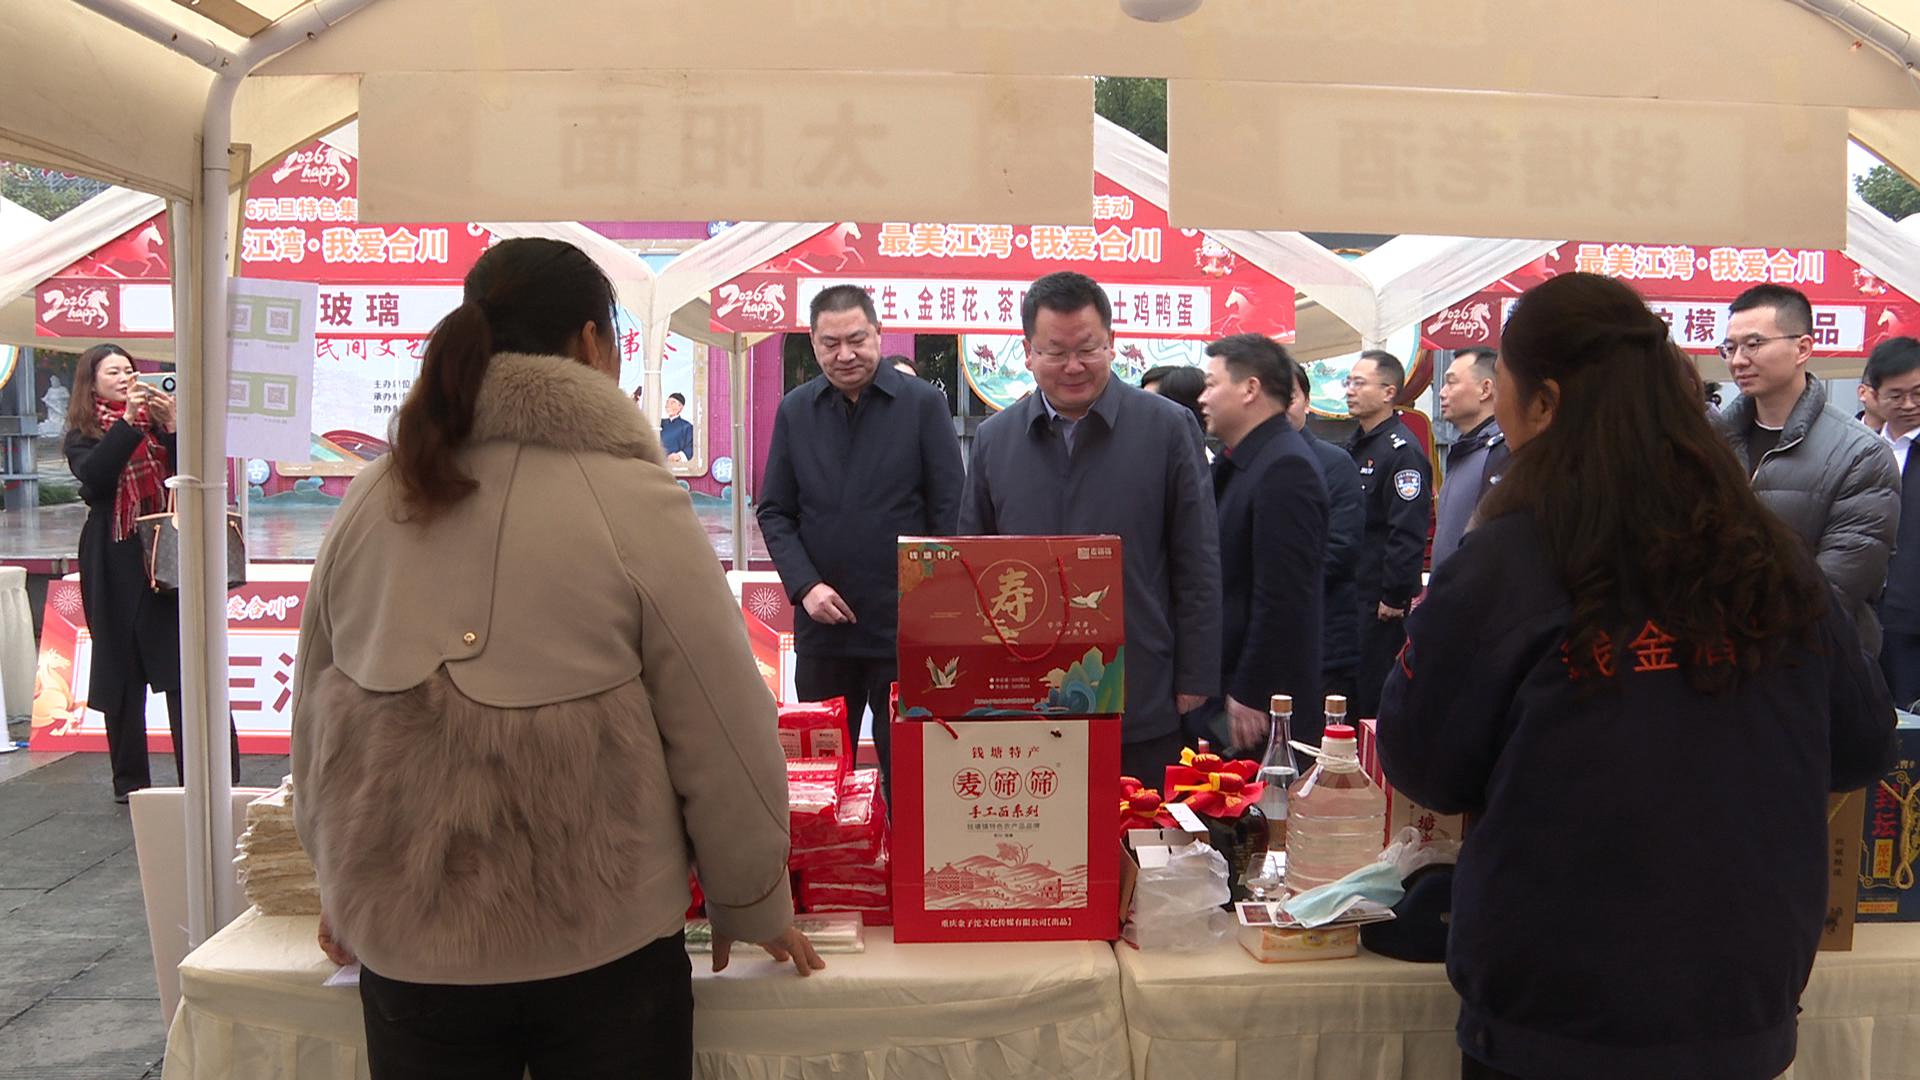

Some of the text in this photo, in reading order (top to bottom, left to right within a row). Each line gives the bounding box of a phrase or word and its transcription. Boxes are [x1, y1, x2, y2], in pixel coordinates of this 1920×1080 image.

[1093, 196, 1134, 219] 活动
[879, 222, 1162, 263] 最美江湾·我爱合川
[42, 288, 87, 323] 2026
[320, 292, 400, 327] 玻璃
[716, 281, 768, 318] 2026
[1112, 290, 1193, 327] 土鸡鸭蛋
